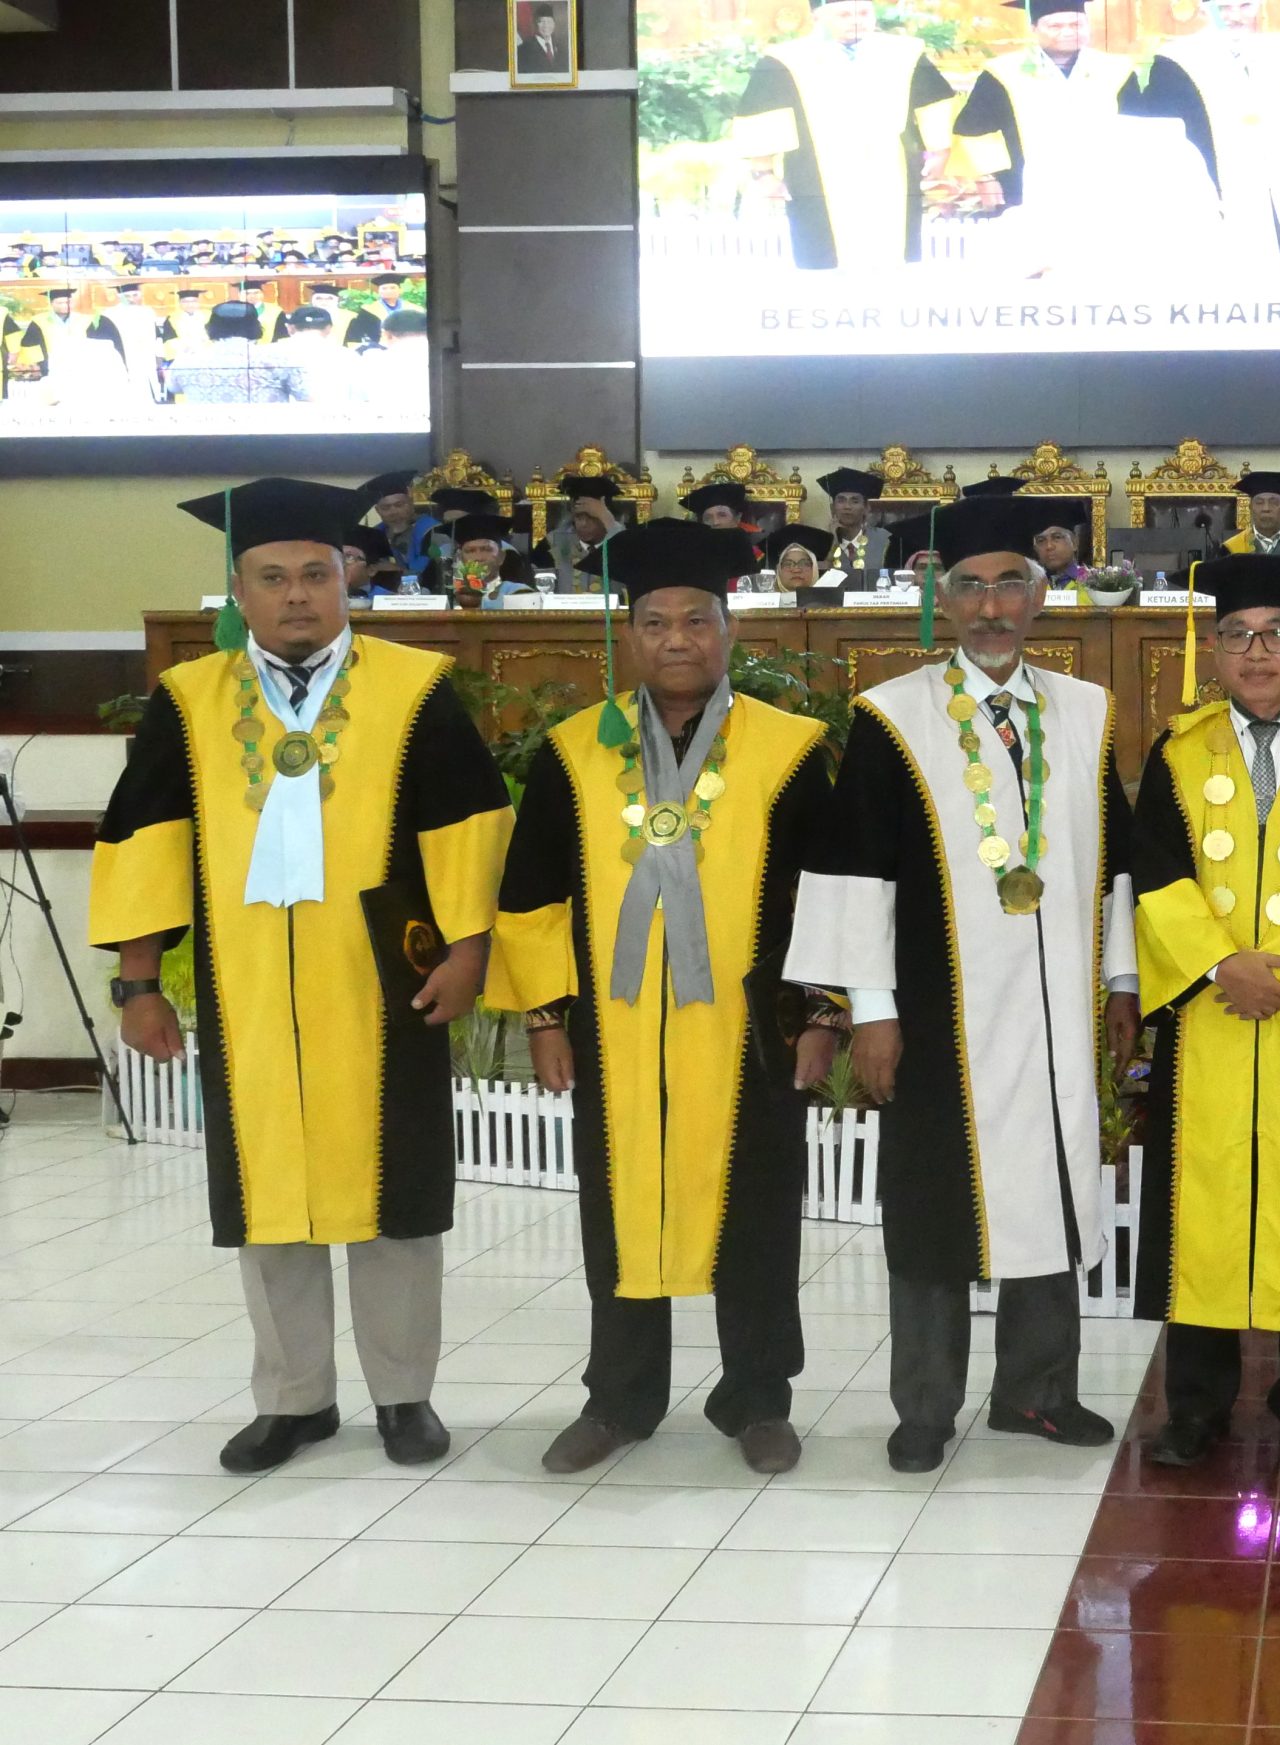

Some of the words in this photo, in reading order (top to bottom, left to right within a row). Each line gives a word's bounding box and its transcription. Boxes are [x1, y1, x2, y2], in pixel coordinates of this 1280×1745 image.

[760, 308, 882, 330] BESAR
[899, 304, 1153, 328] UNIVERSITAS
[1147, 595, 1178, 604] KETUA
